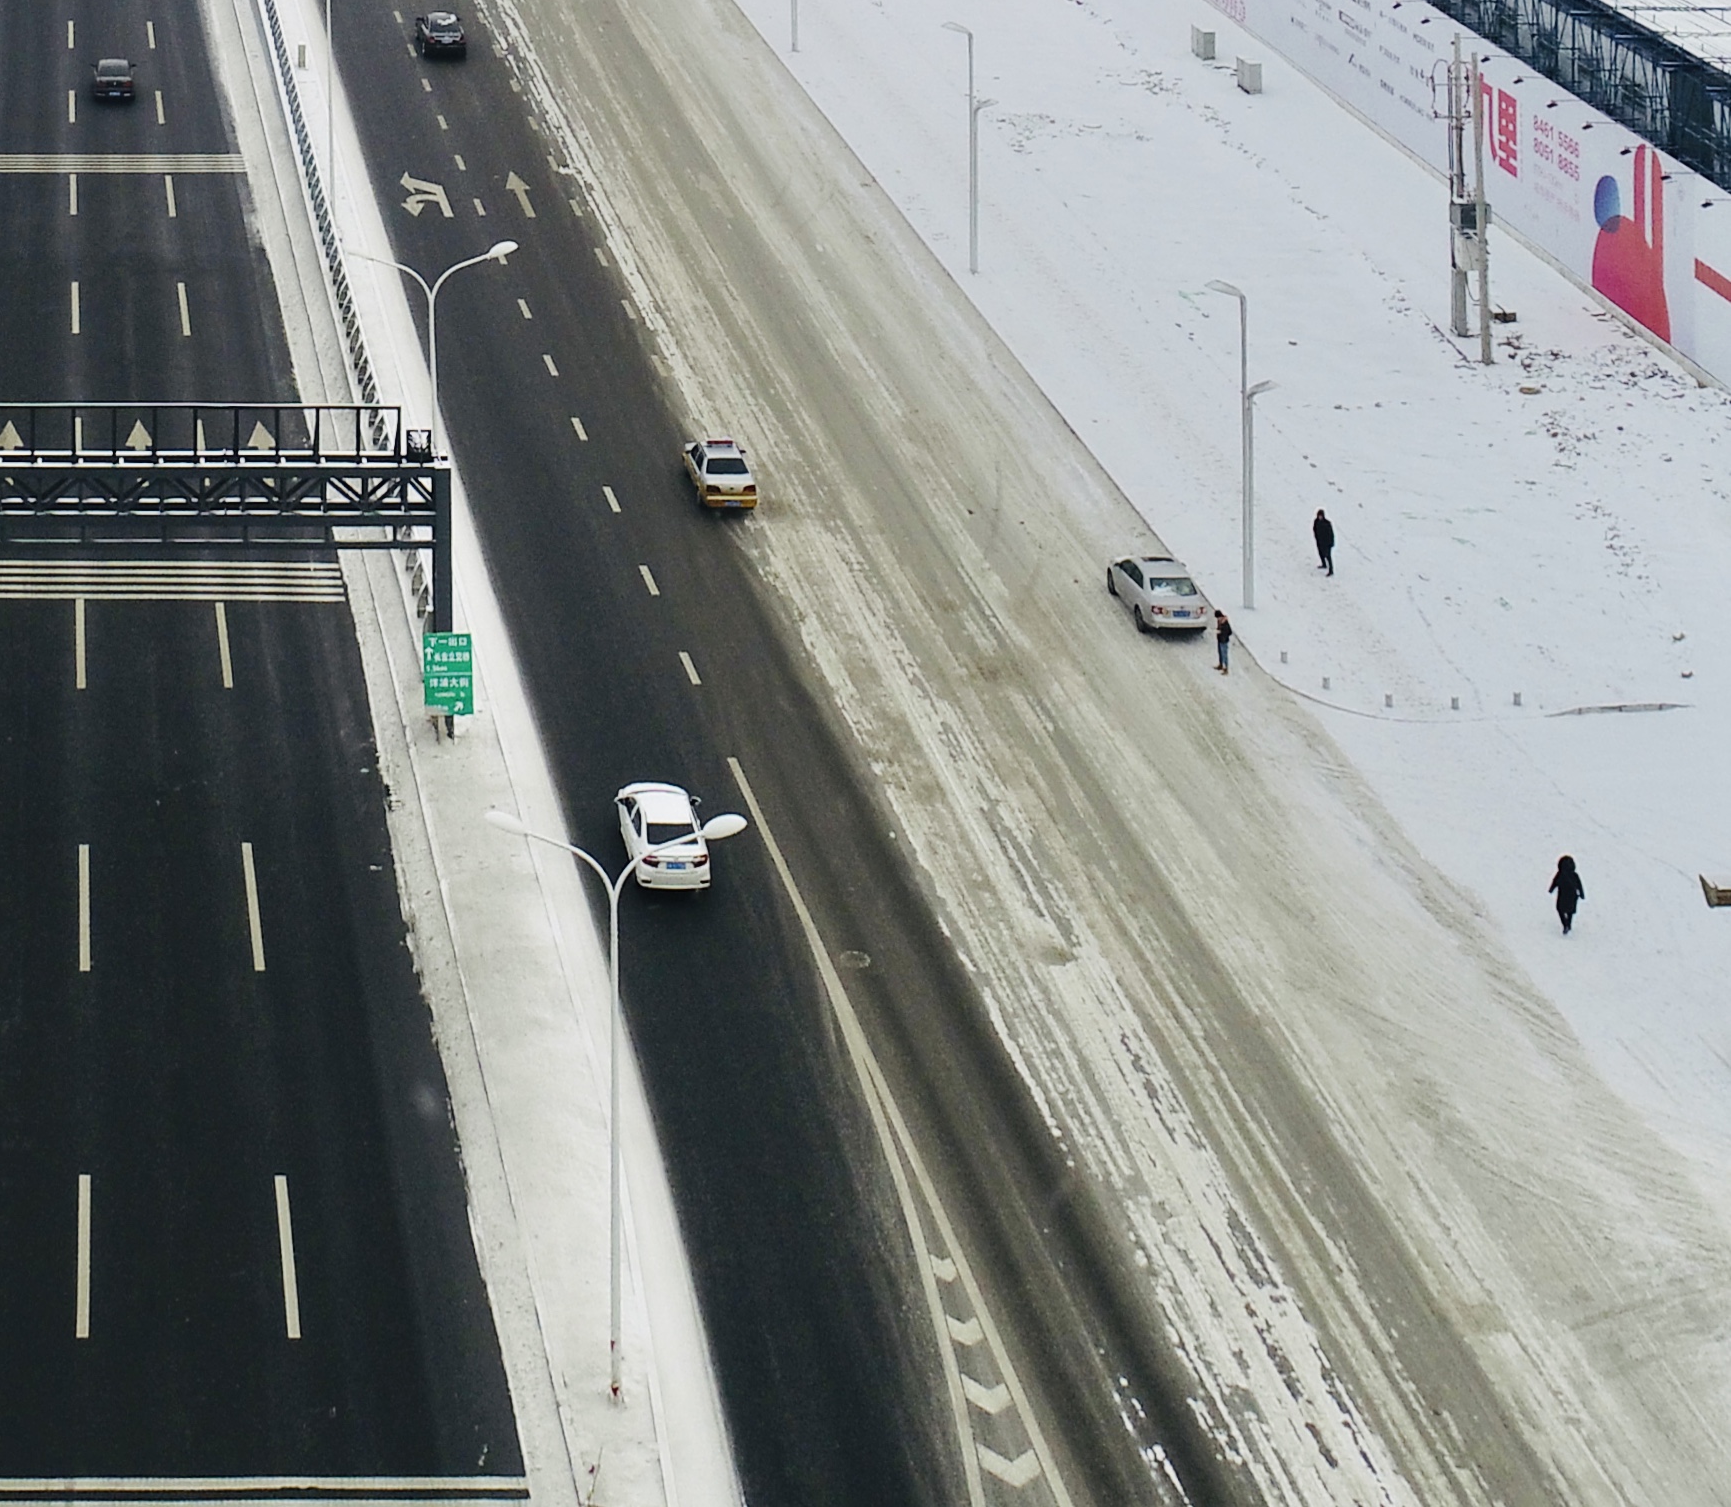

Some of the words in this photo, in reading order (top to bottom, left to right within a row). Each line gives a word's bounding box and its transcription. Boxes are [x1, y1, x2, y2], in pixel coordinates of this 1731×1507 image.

[1533, 114, 1554, 141] 8461
[1533, 137, 1554, 164] 8051
[428, 636, 468, 647] 下一出口
